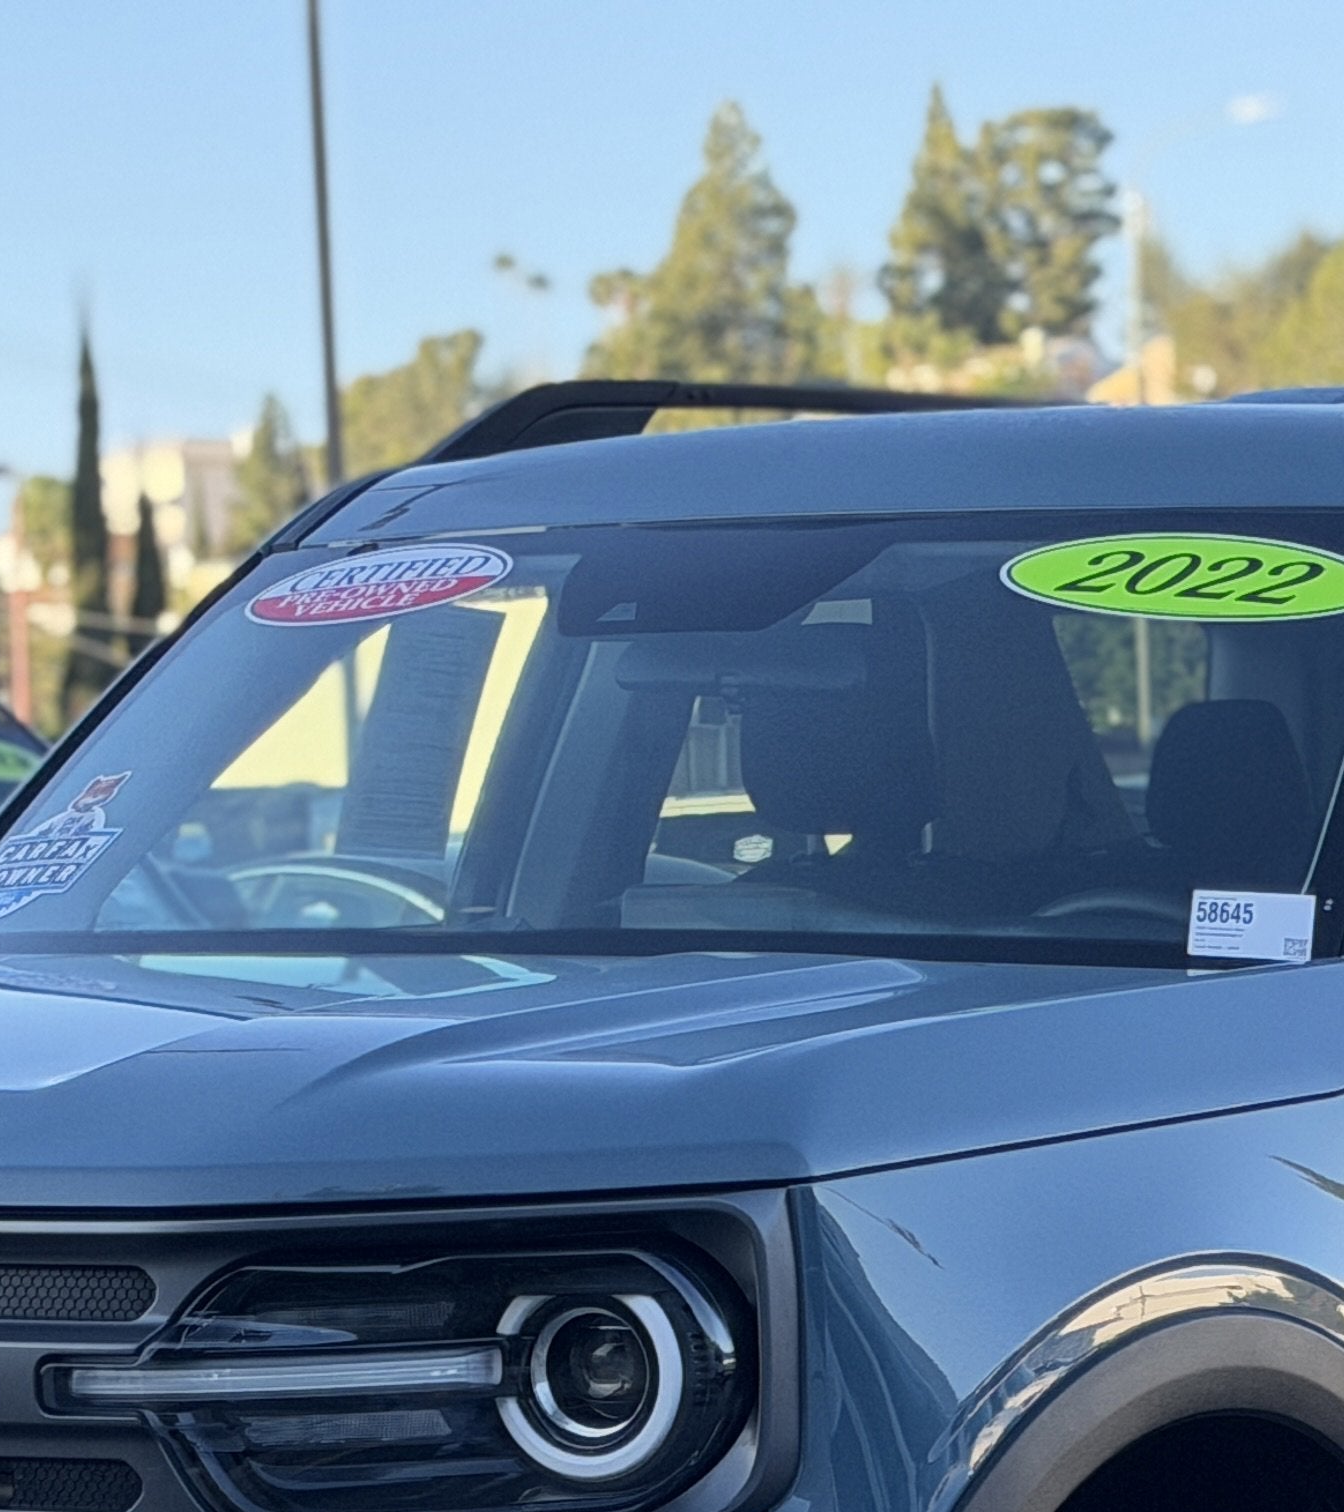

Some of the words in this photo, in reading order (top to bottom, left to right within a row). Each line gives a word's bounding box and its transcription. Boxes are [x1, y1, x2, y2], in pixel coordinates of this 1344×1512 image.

[289, 555, 491, 592] CERTIFIED
[1054, 550, 1325, 605] 2022
[278, 578, 458, 608] PRE-OWNED
[293, 593, 420, 617] VEHICLE
[1196, 901, 1254, 925] 58645
